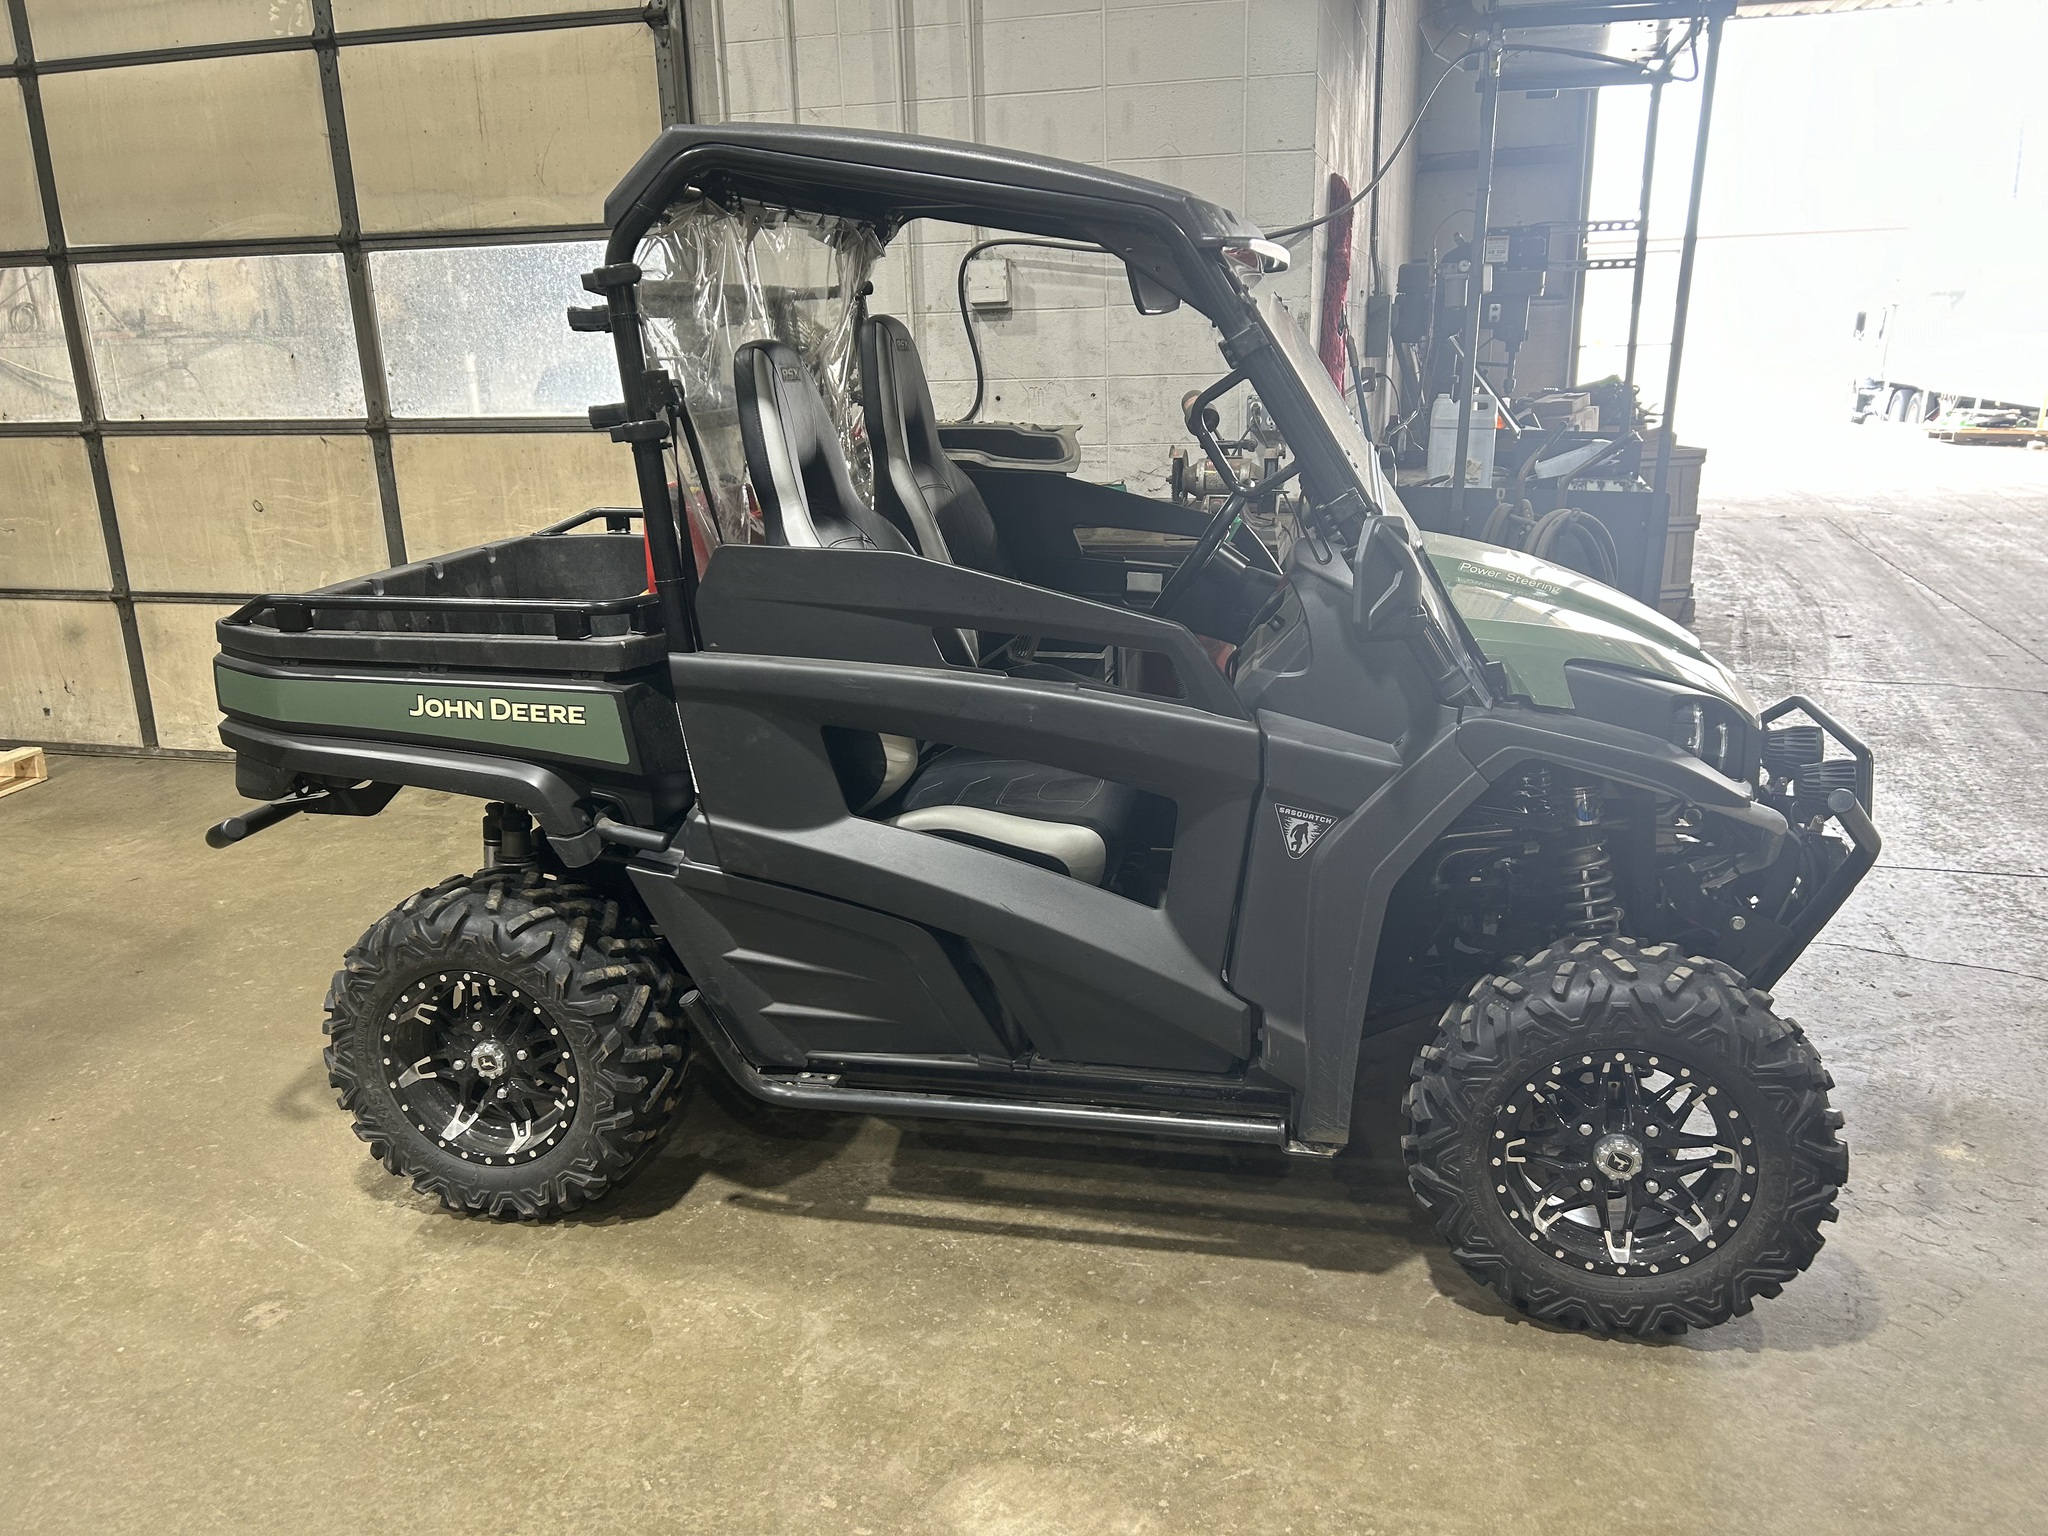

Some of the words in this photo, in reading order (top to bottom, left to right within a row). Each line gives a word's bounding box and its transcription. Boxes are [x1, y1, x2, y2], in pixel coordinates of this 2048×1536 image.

[1460, 561, 1502, 579] Power
[1505, 573, 1561, 595] Steering
[409, 694, 484, 720] JOHN
[489, 697, 586, 725] DEERE
[1279, 807, 1332, 825] SASQUATCH
